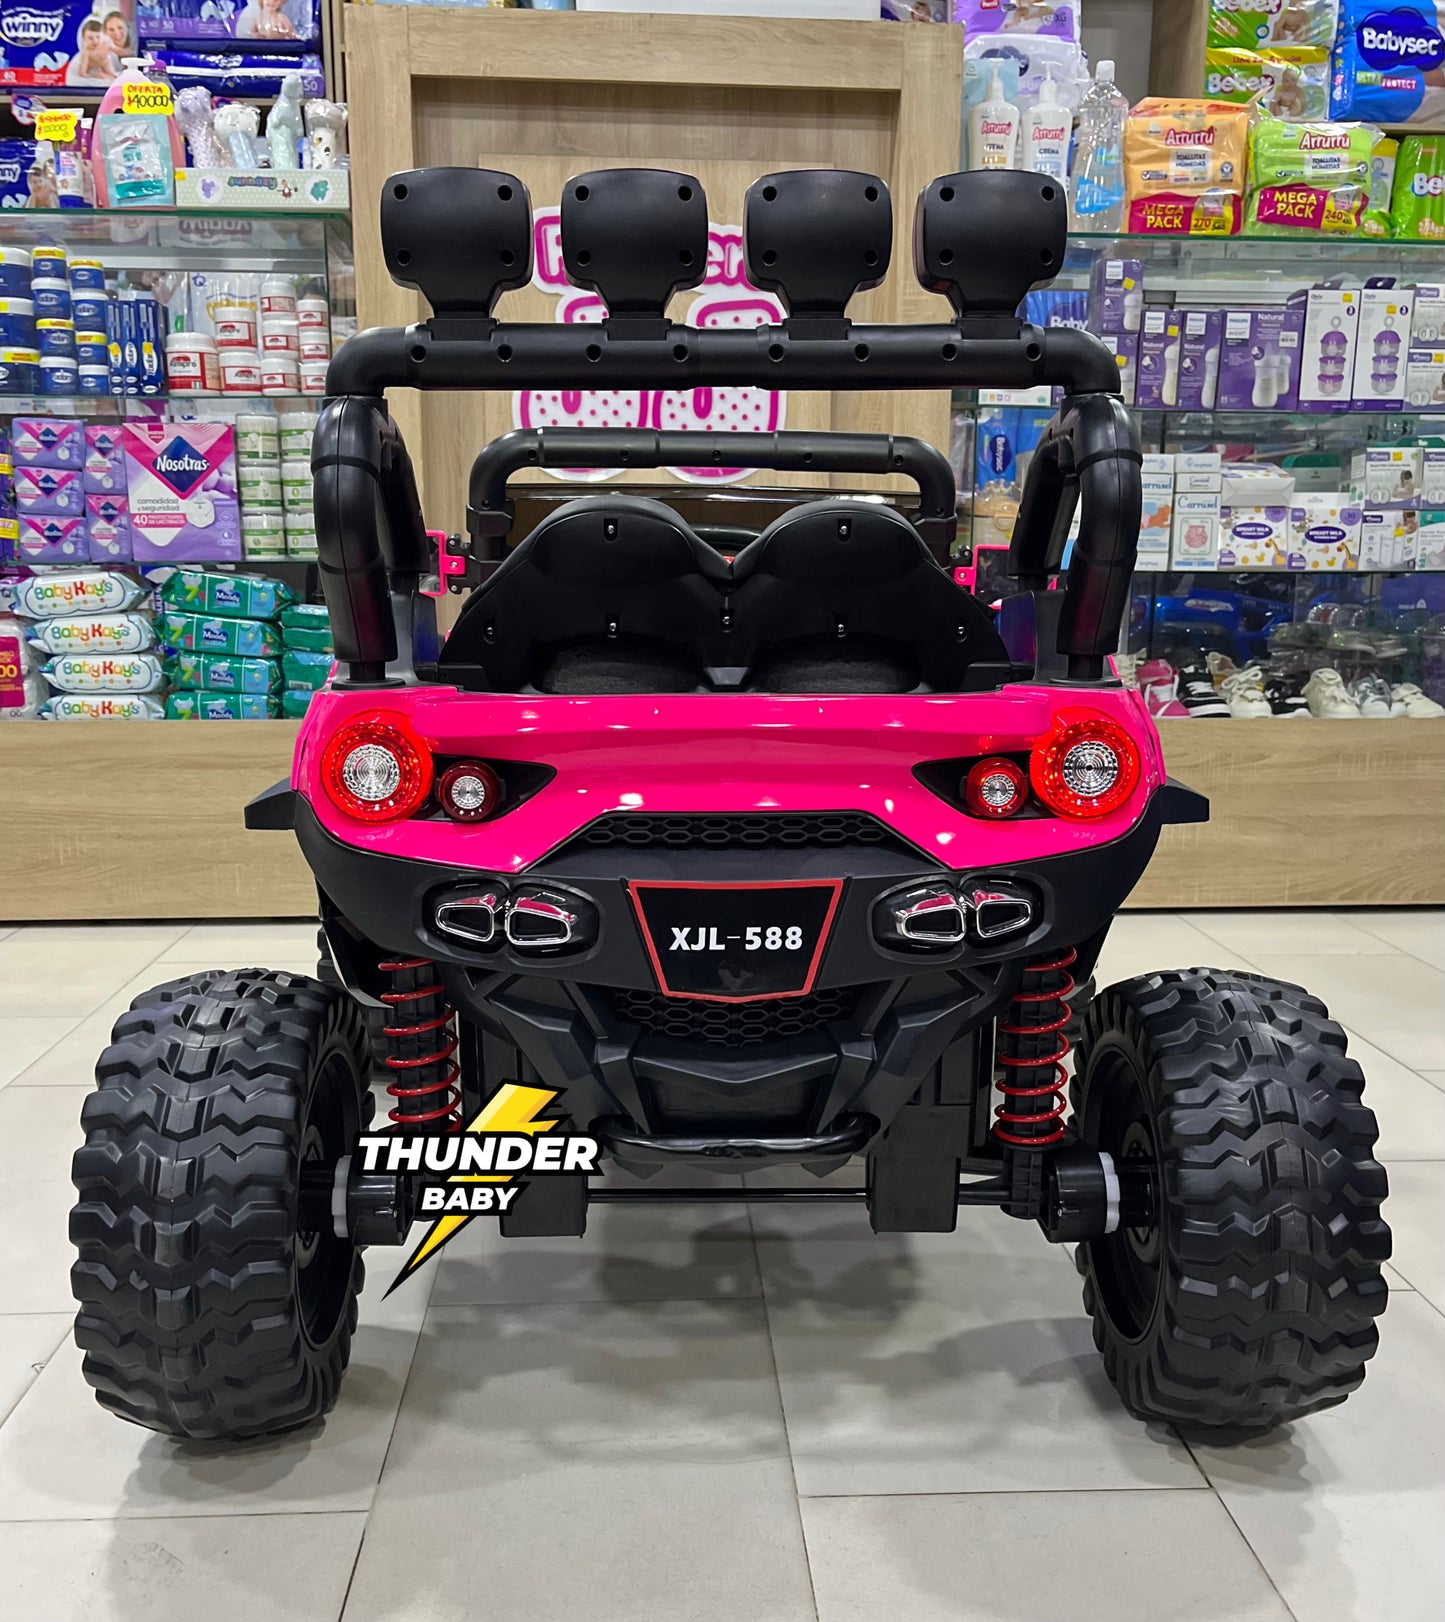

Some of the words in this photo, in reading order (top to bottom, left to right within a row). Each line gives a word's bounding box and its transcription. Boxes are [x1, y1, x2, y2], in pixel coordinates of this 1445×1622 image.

[4, 15, 61, 37] winny
[1362, 28, 1441, 55] Babysec
[128, 85, 163, 95] OFERTA
[1165, 126, 1216, 146] Arrurrú
[1274, 190, 1318, 205] MEGA
[1142, 203, 1184, 216] MEGA
[1276, 203, 1316, 218] PACK
[1146, 215, 1183, 228] PACK
[1258, 313, 1285, 321] Natural
[156, 454, 209, 472] Nosotras
[1142, 477, 1172, 490] arrusel
[141, 504, 180, 513] seguridad
[1177, 495, 1218, 509] Carrusel
[133, 514, 148, 525] 40
[34, 583, 73, 601] Baby
[74, 580, 113, 597] Kay's
[51, 624, 90, 642] Baby
[91, 623, 130, 640] Kay's
[63, 661, 101, 678] Baby
[102, 660, 141, 678] Kay's
[62, 701, 100, 717] Baby
[101, 701, 140, 718] Kay's
[669, 926, 803, 951] XJL-588
